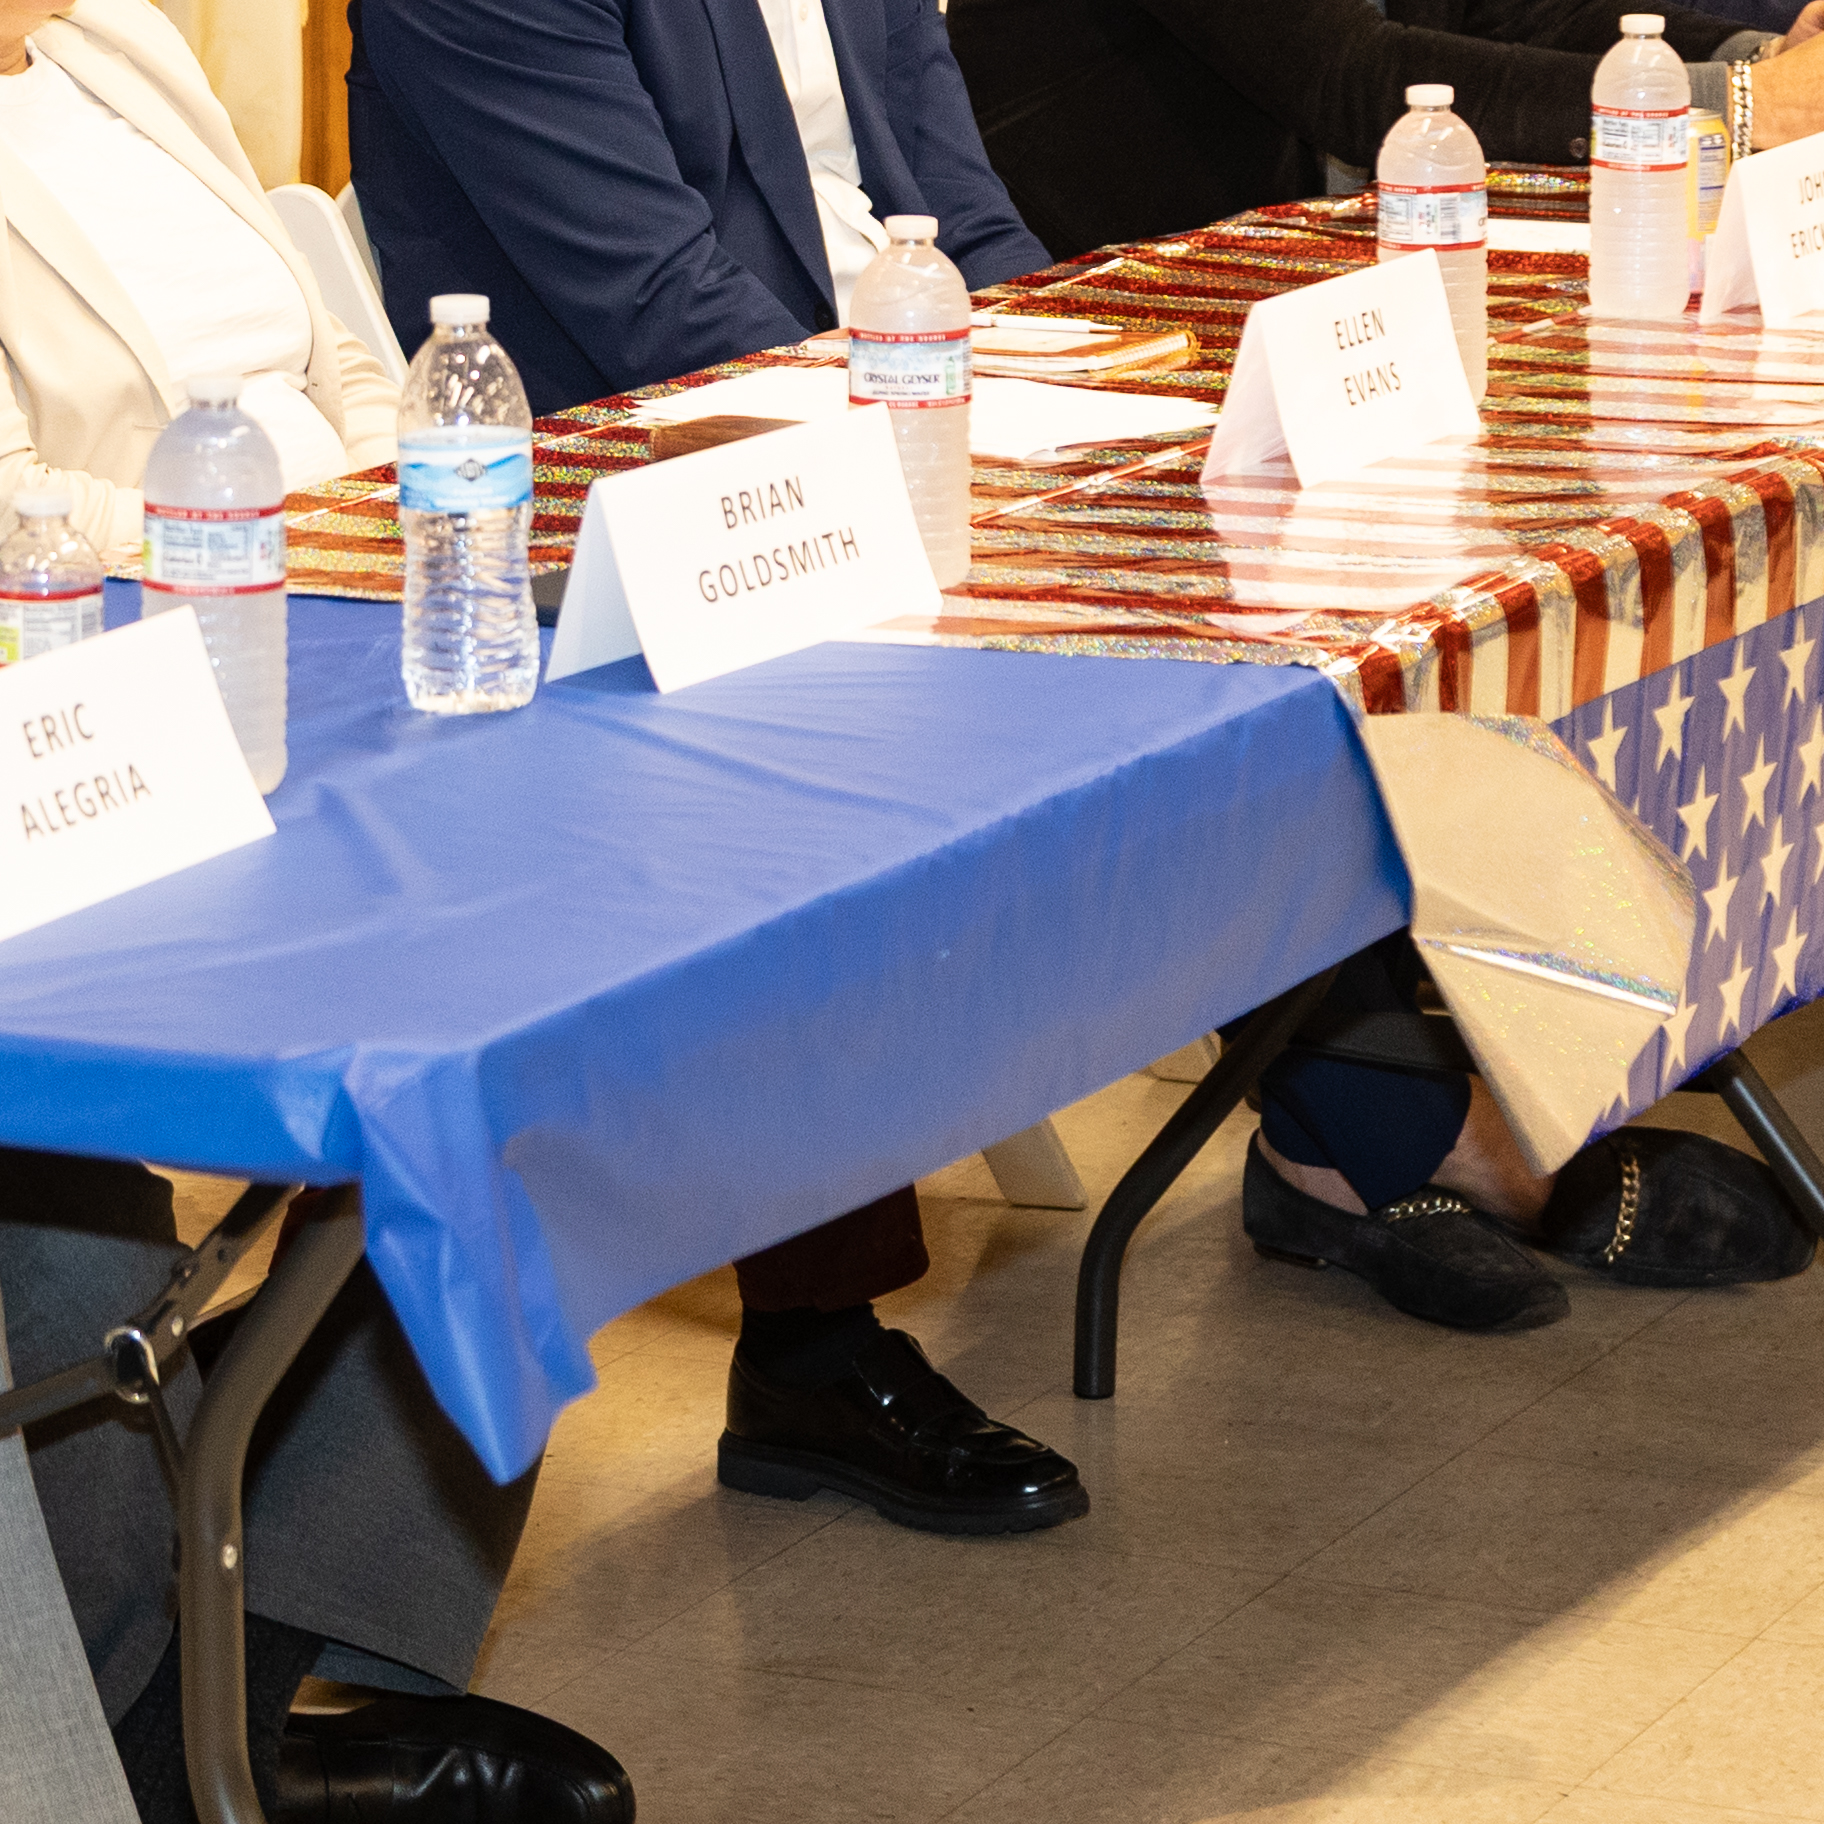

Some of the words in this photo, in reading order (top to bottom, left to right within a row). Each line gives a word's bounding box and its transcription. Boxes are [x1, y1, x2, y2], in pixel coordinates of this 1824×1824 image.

[1335, 307, 1385, 350] ELLEN
[864, 372, 898, 384] CRYSTAL
[902, 374, 941, 384] GEYSER
[1344, 361, 1401, 406] EVANS
[721, 475, 804, 529] BRIAN
[699, 526, 860, 603] GOLDSMITH
[23, 702, 94, 759] ERIC
[21, 763, 152, 843] ALEGRIA
